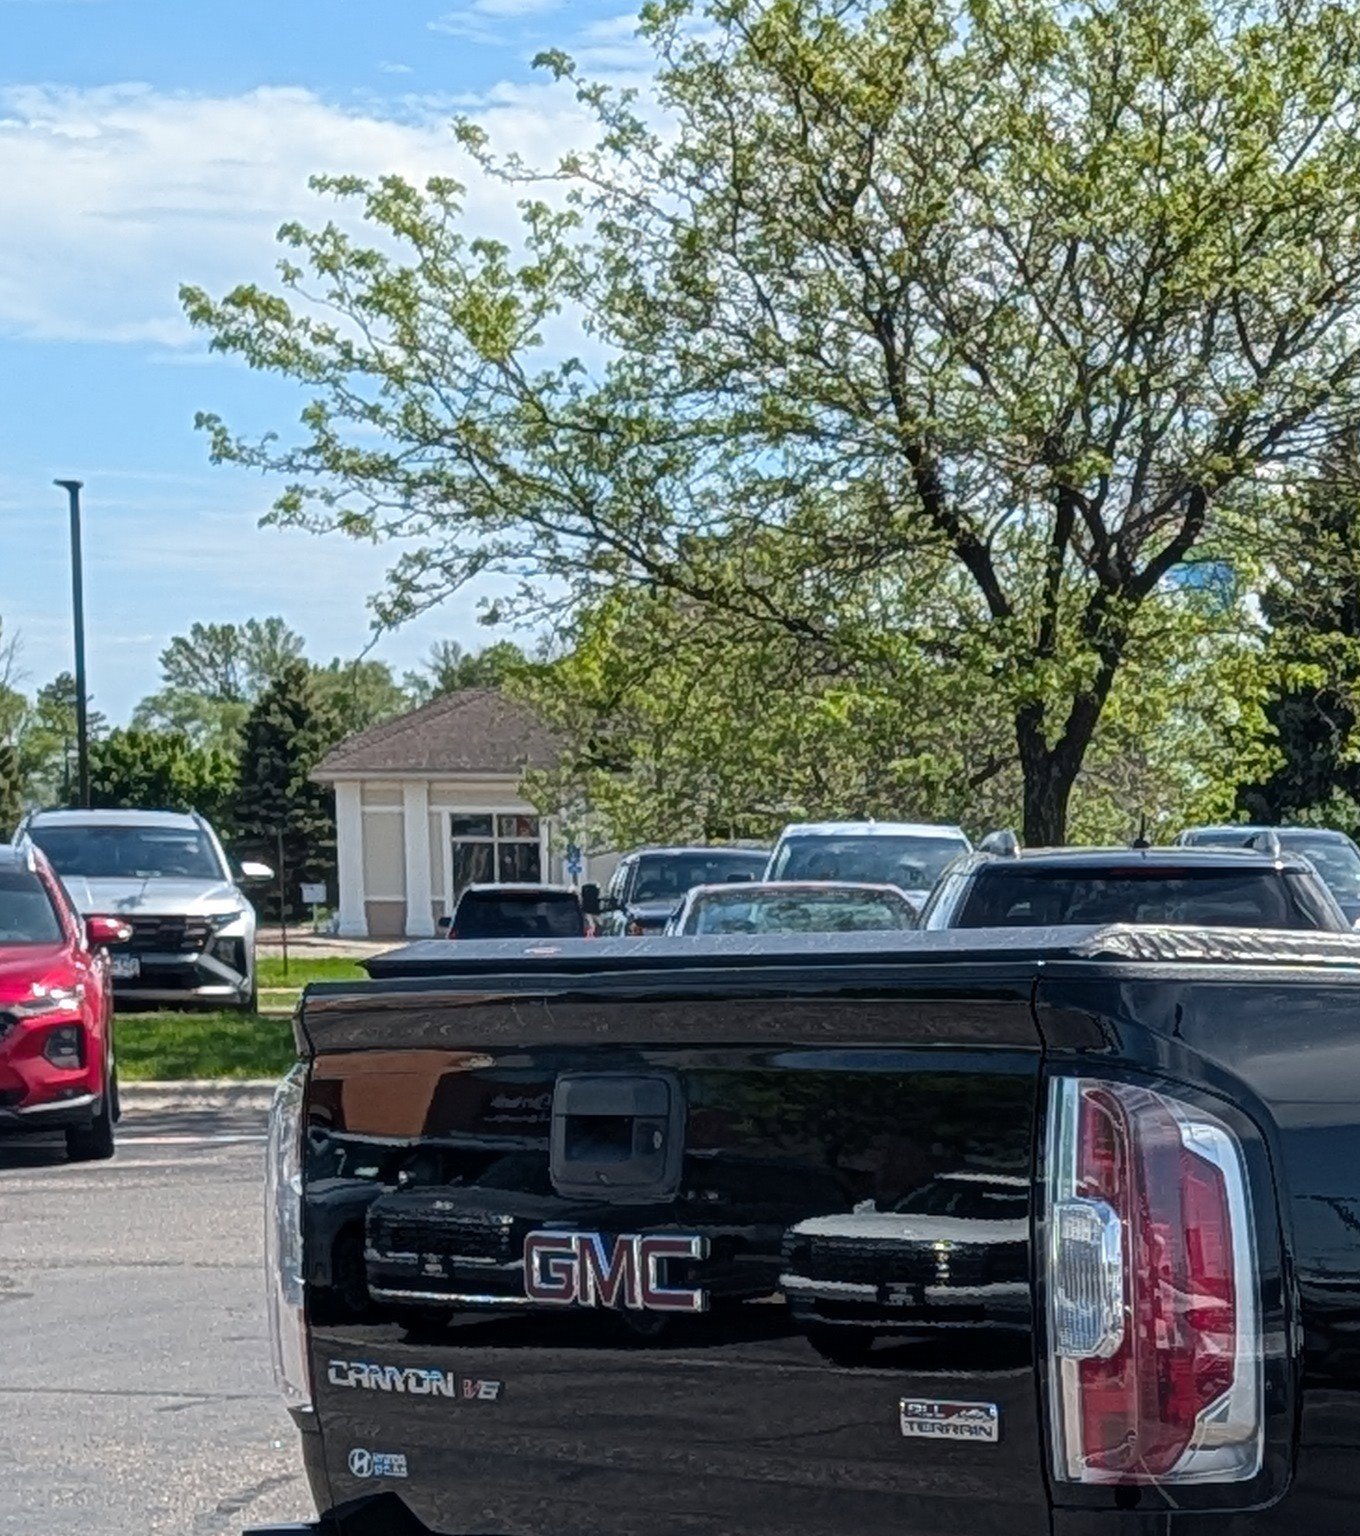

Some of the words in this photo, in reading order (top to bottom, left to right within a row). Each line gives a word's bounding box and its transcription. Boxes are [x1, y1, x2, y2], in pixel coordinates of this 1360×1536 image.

[523, 1231, 709, 1312] GMC
[328, 1359, 456, 1398] CANYON
[904, 1420, 994, 1438] TERRAIN
